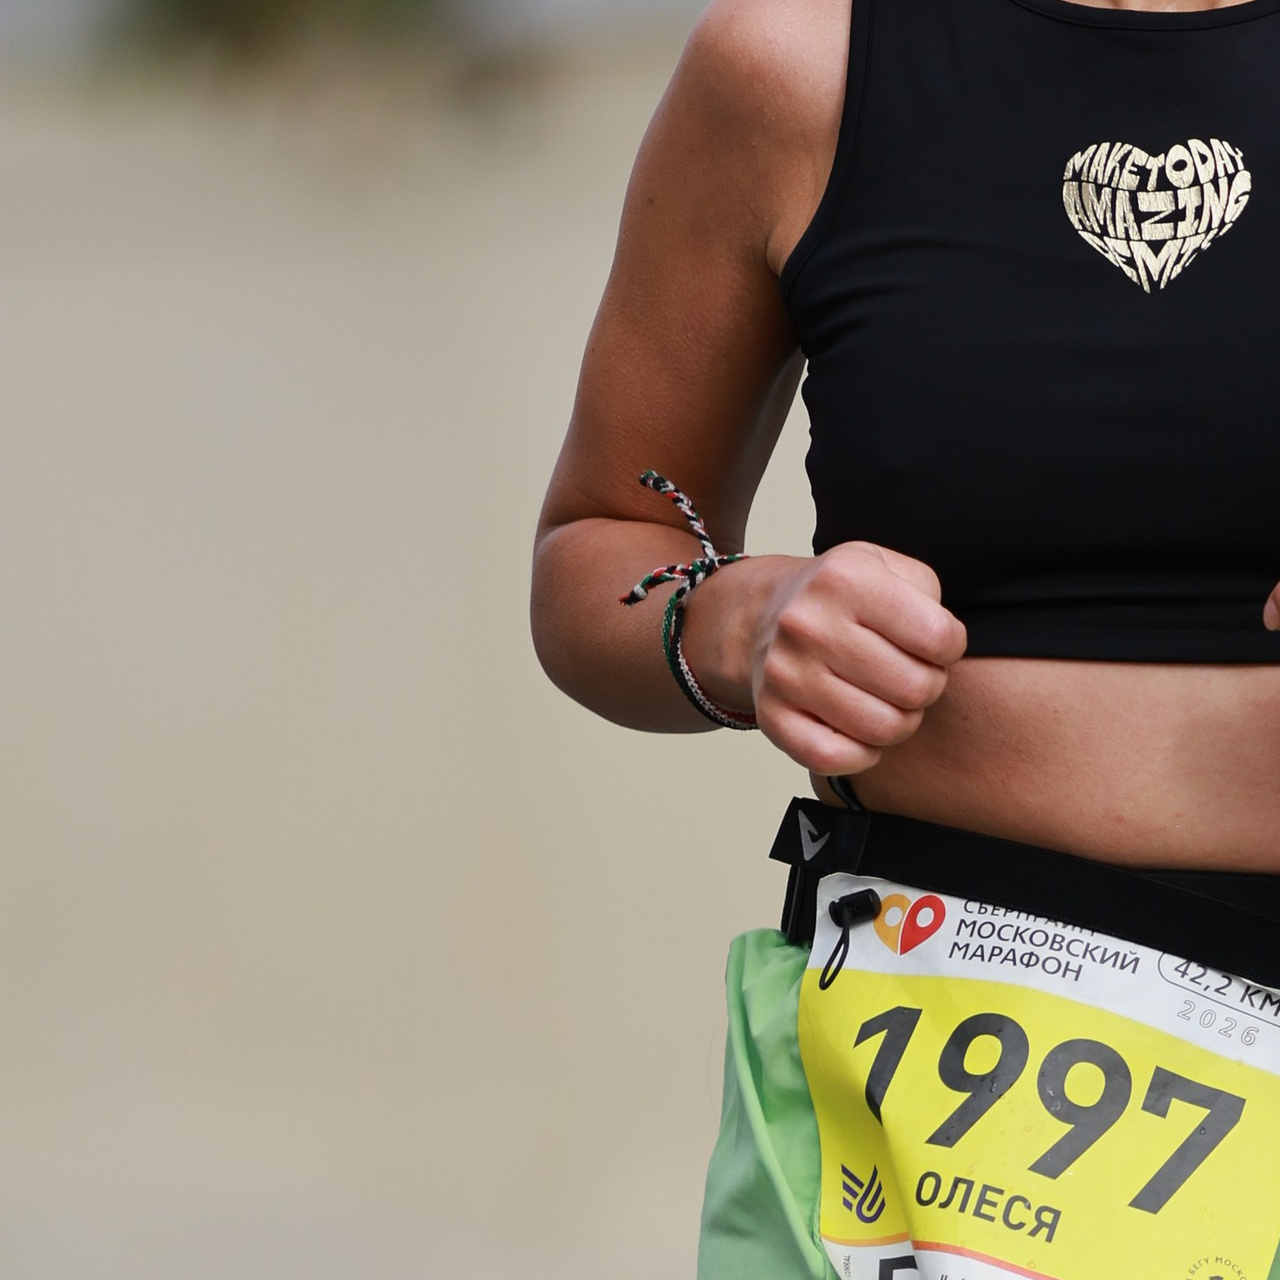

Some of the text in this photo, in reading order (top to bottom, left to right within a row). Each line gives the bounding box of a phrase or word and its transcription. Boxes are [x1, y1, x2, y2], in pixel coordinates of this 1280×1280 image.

[1062, 169, 1252, 241] AMAZING
[949, 942, 1083, 982] МАРАФОН
[955, 918, 1140, 974] МОСКОВСКИЙ
[1174, 959, 1233, 996] 42,2
[1177, 999, 1260, 1046] 2026
[852, 1005, 1247, 1215] 1997
[915, 1171, 1062, 1244] ОЛЕСЯ
[1188, 1256, 1209, 1275] БЕГУ
